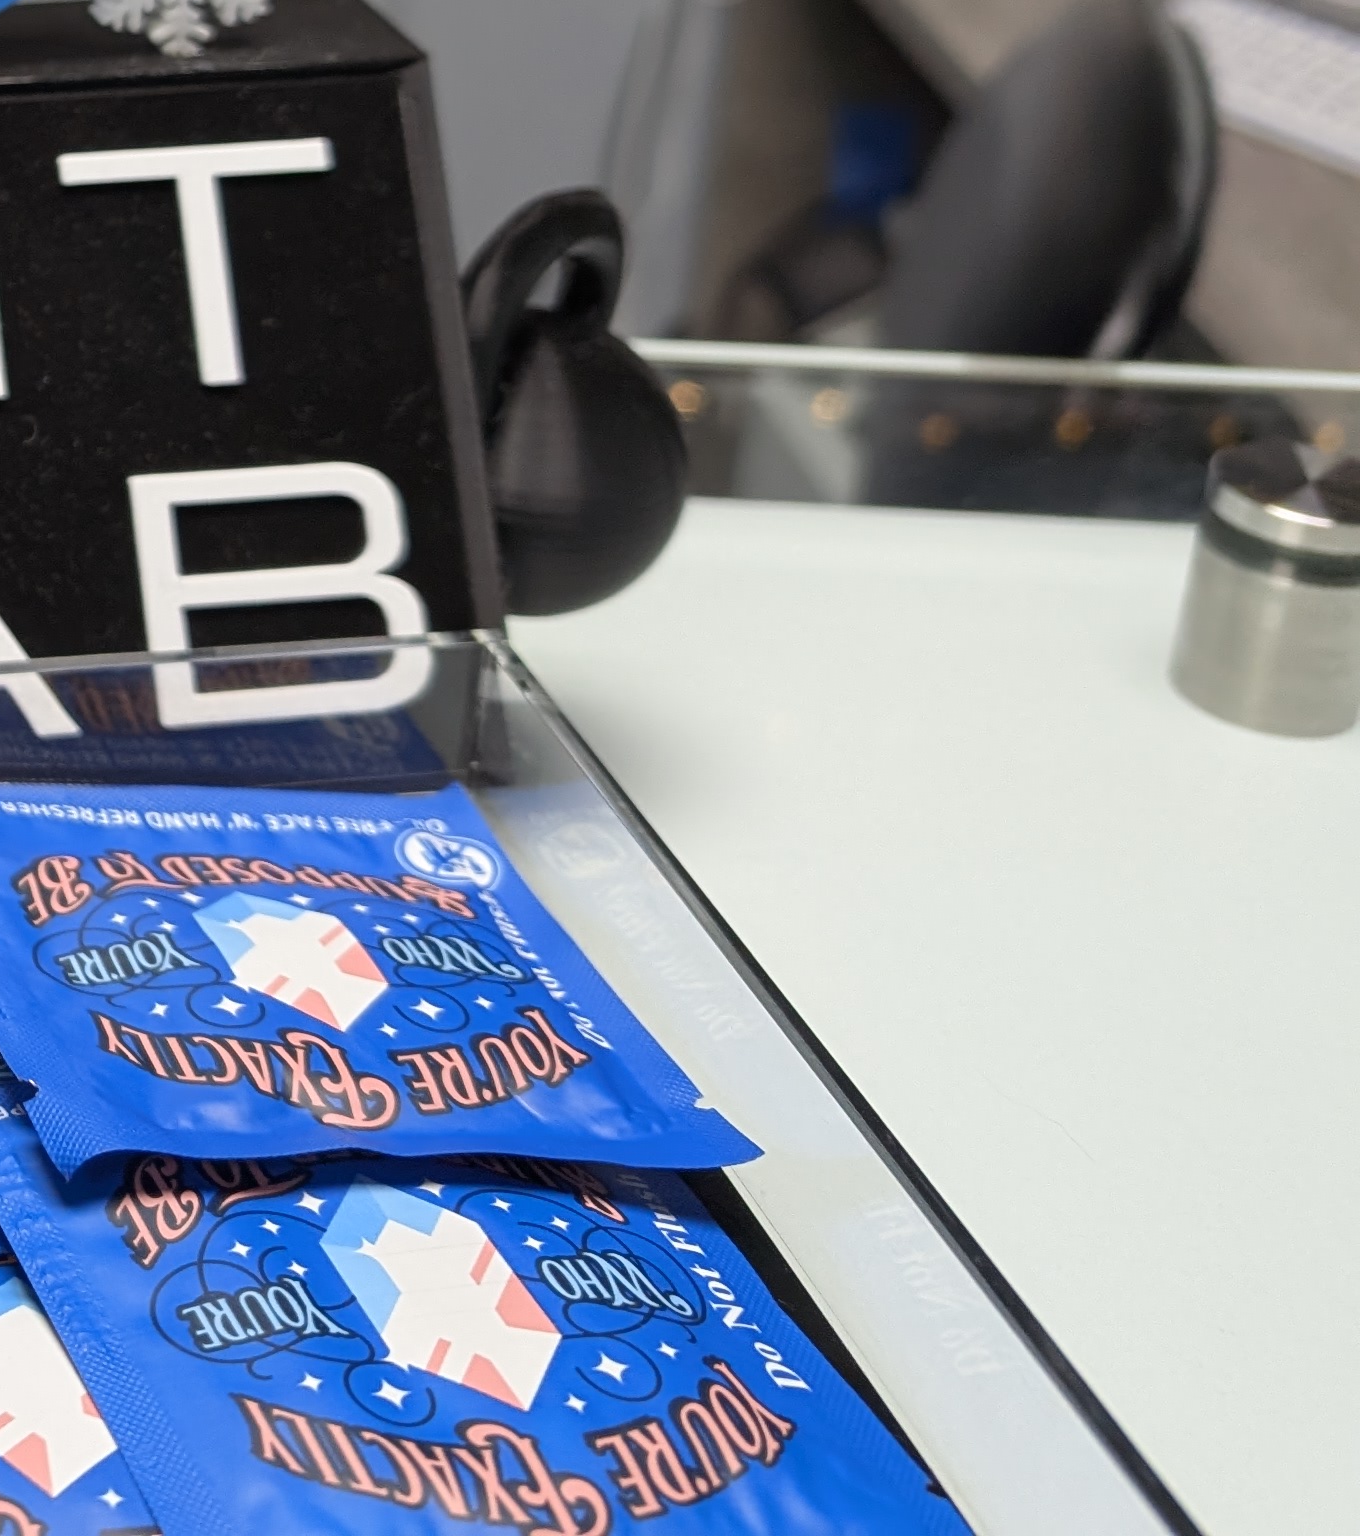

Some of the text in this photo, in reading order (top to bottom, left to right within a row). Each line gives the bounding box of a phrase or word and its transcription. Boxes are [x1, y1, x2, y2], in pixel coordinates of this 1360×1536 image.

[1, 801, 141, 826] REFRESHER
[146, 813, 223, 831] HAND
[17, 855, 94, 927] BE
[96, 851, 185, 898] TO
[58, 932, 202, 985] YOU'RE
[382, 935, 524, 981] WHO
[98, 1010, 589, 1129] YOU'RE EXACTLY
[116, 1156, 202, 1267] BE
[182, 1276, 351, 1350] YOU'RE
[540, 1250, 693, 1317] WHO
[690, 1264, 762, 1334] Not
[753, 1340, 813, 1393] Do
[238, 1359, 794, 1536] YOU'RE EXACTLY
